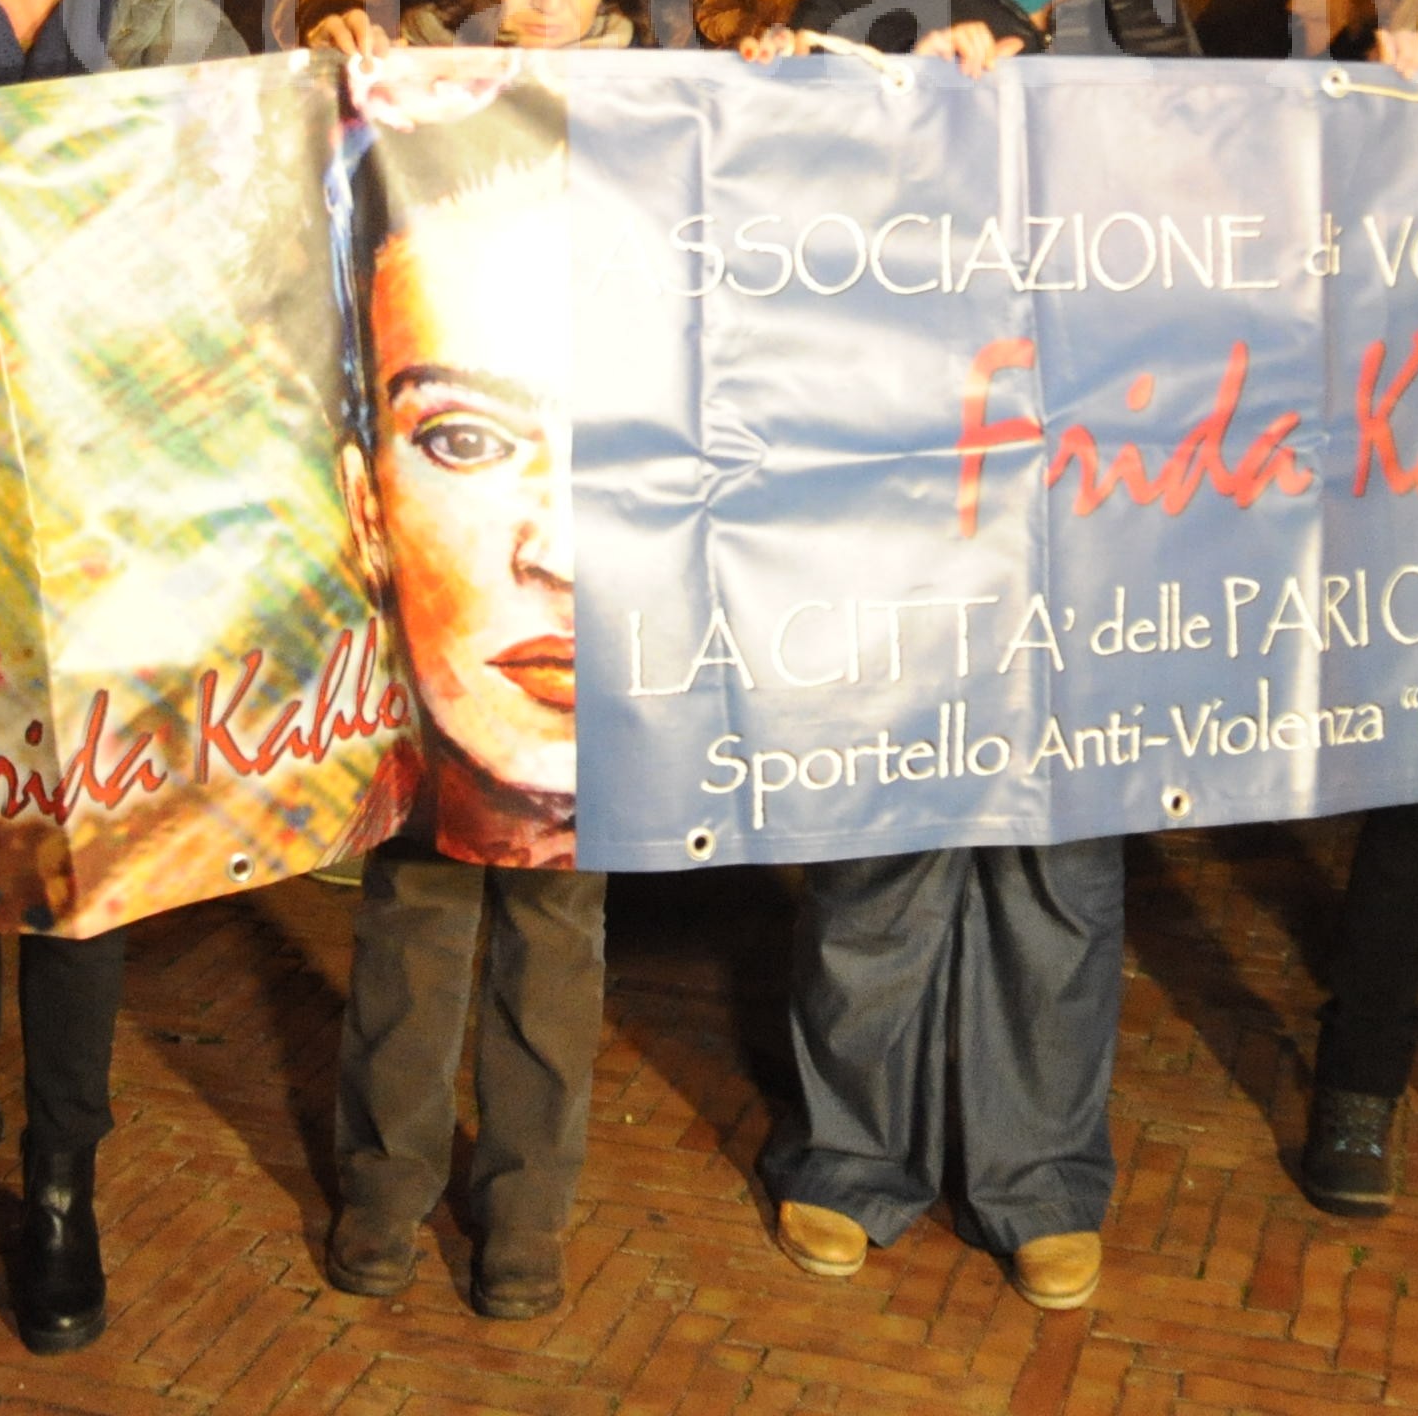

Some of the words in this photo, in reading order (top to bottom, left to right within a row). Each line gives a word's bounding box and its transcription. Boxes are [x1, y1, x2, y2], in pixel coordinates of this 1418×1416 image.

[1303, 213, 1343, 278] di
[955, 337, 1314, 540] Frida
[194, 616, 410, 784] Kahlo
[626, 607, 756, 698] LA
[771, 594, 1077, 687] CITTA'
[1089, 581, 1213, 657] delle
[699, 701, 1011, 831] Sportello
[1027, 677, 1386, 777] Anti-Violenza
